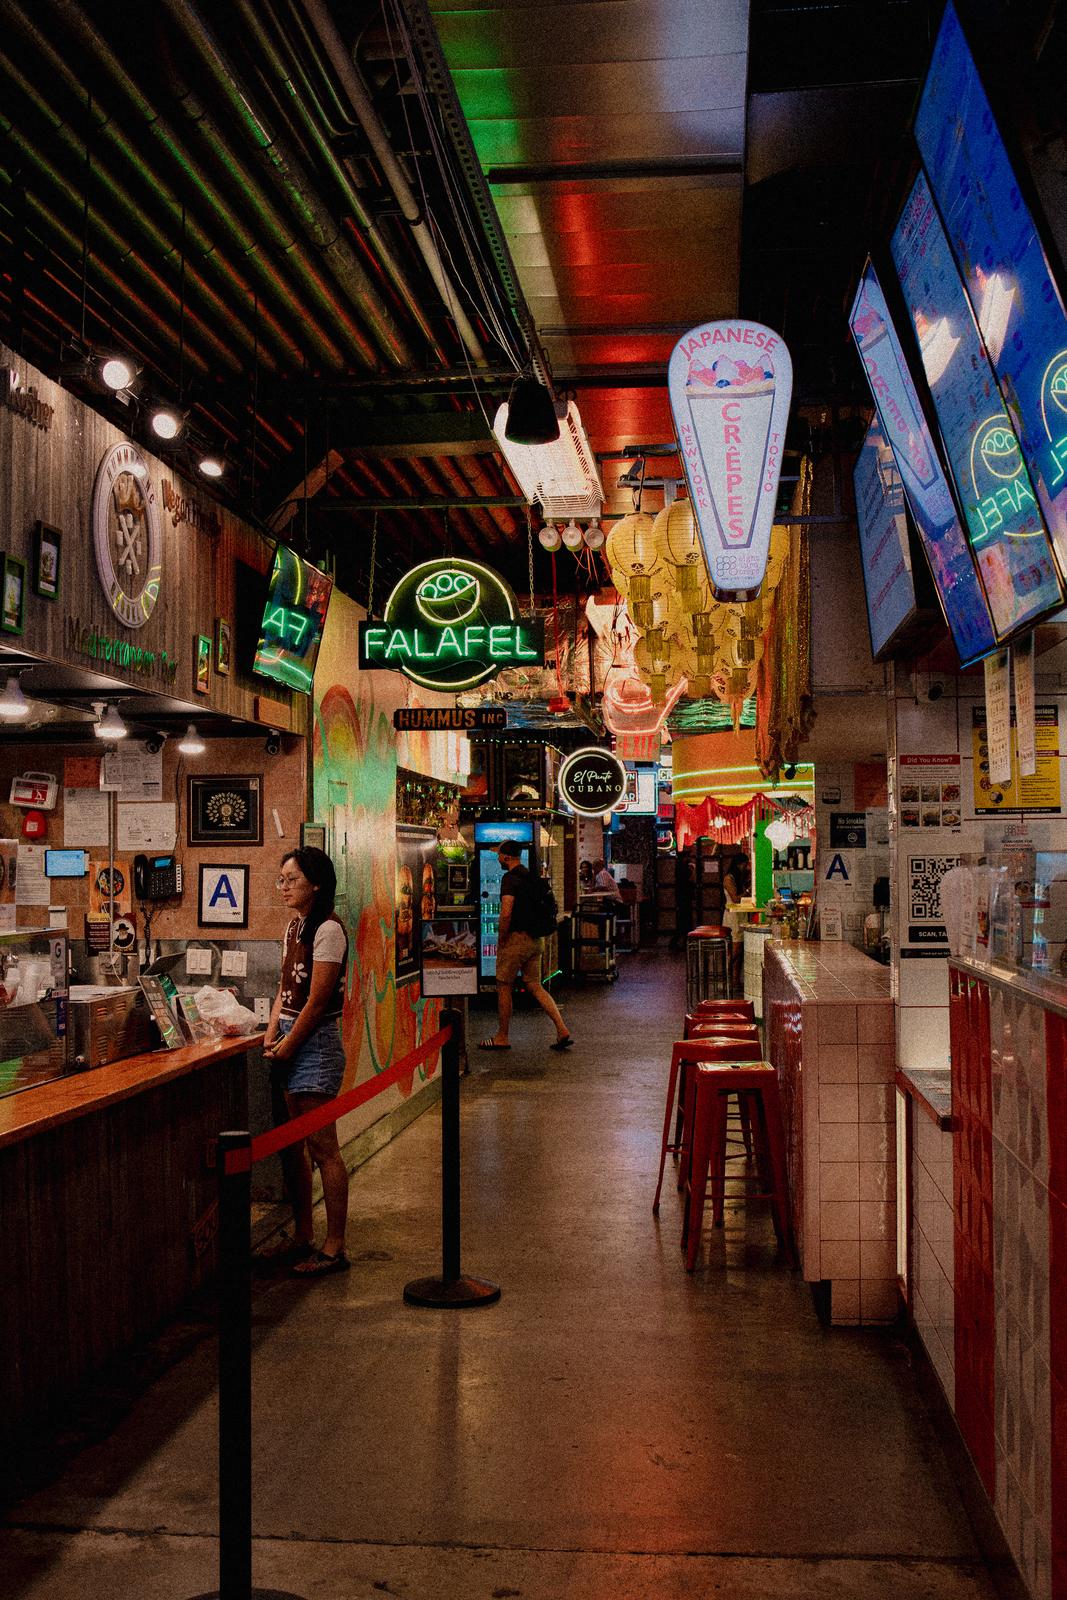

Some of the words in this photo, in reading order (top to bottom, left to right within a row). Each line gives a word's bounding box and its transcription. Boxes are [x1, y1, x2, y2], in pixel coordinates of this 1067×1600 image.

[678, 327, 779, 361] JAPANESE
[680, 424, 698, 459] NEW
[690, 462, 708, 508] YORK
[764, 432, 780, 493] TOKYO
[365, 625, 537, 660] FALAFEL
[399, 710, 476, 728] HUMMUS
[482, 713, 503, 724] INC
[568, 785, 622, 793] CUBANO
[573, 770, 588, 785] El
[826, 853, 849, 881] A
[208, 874, 238, 908] A
